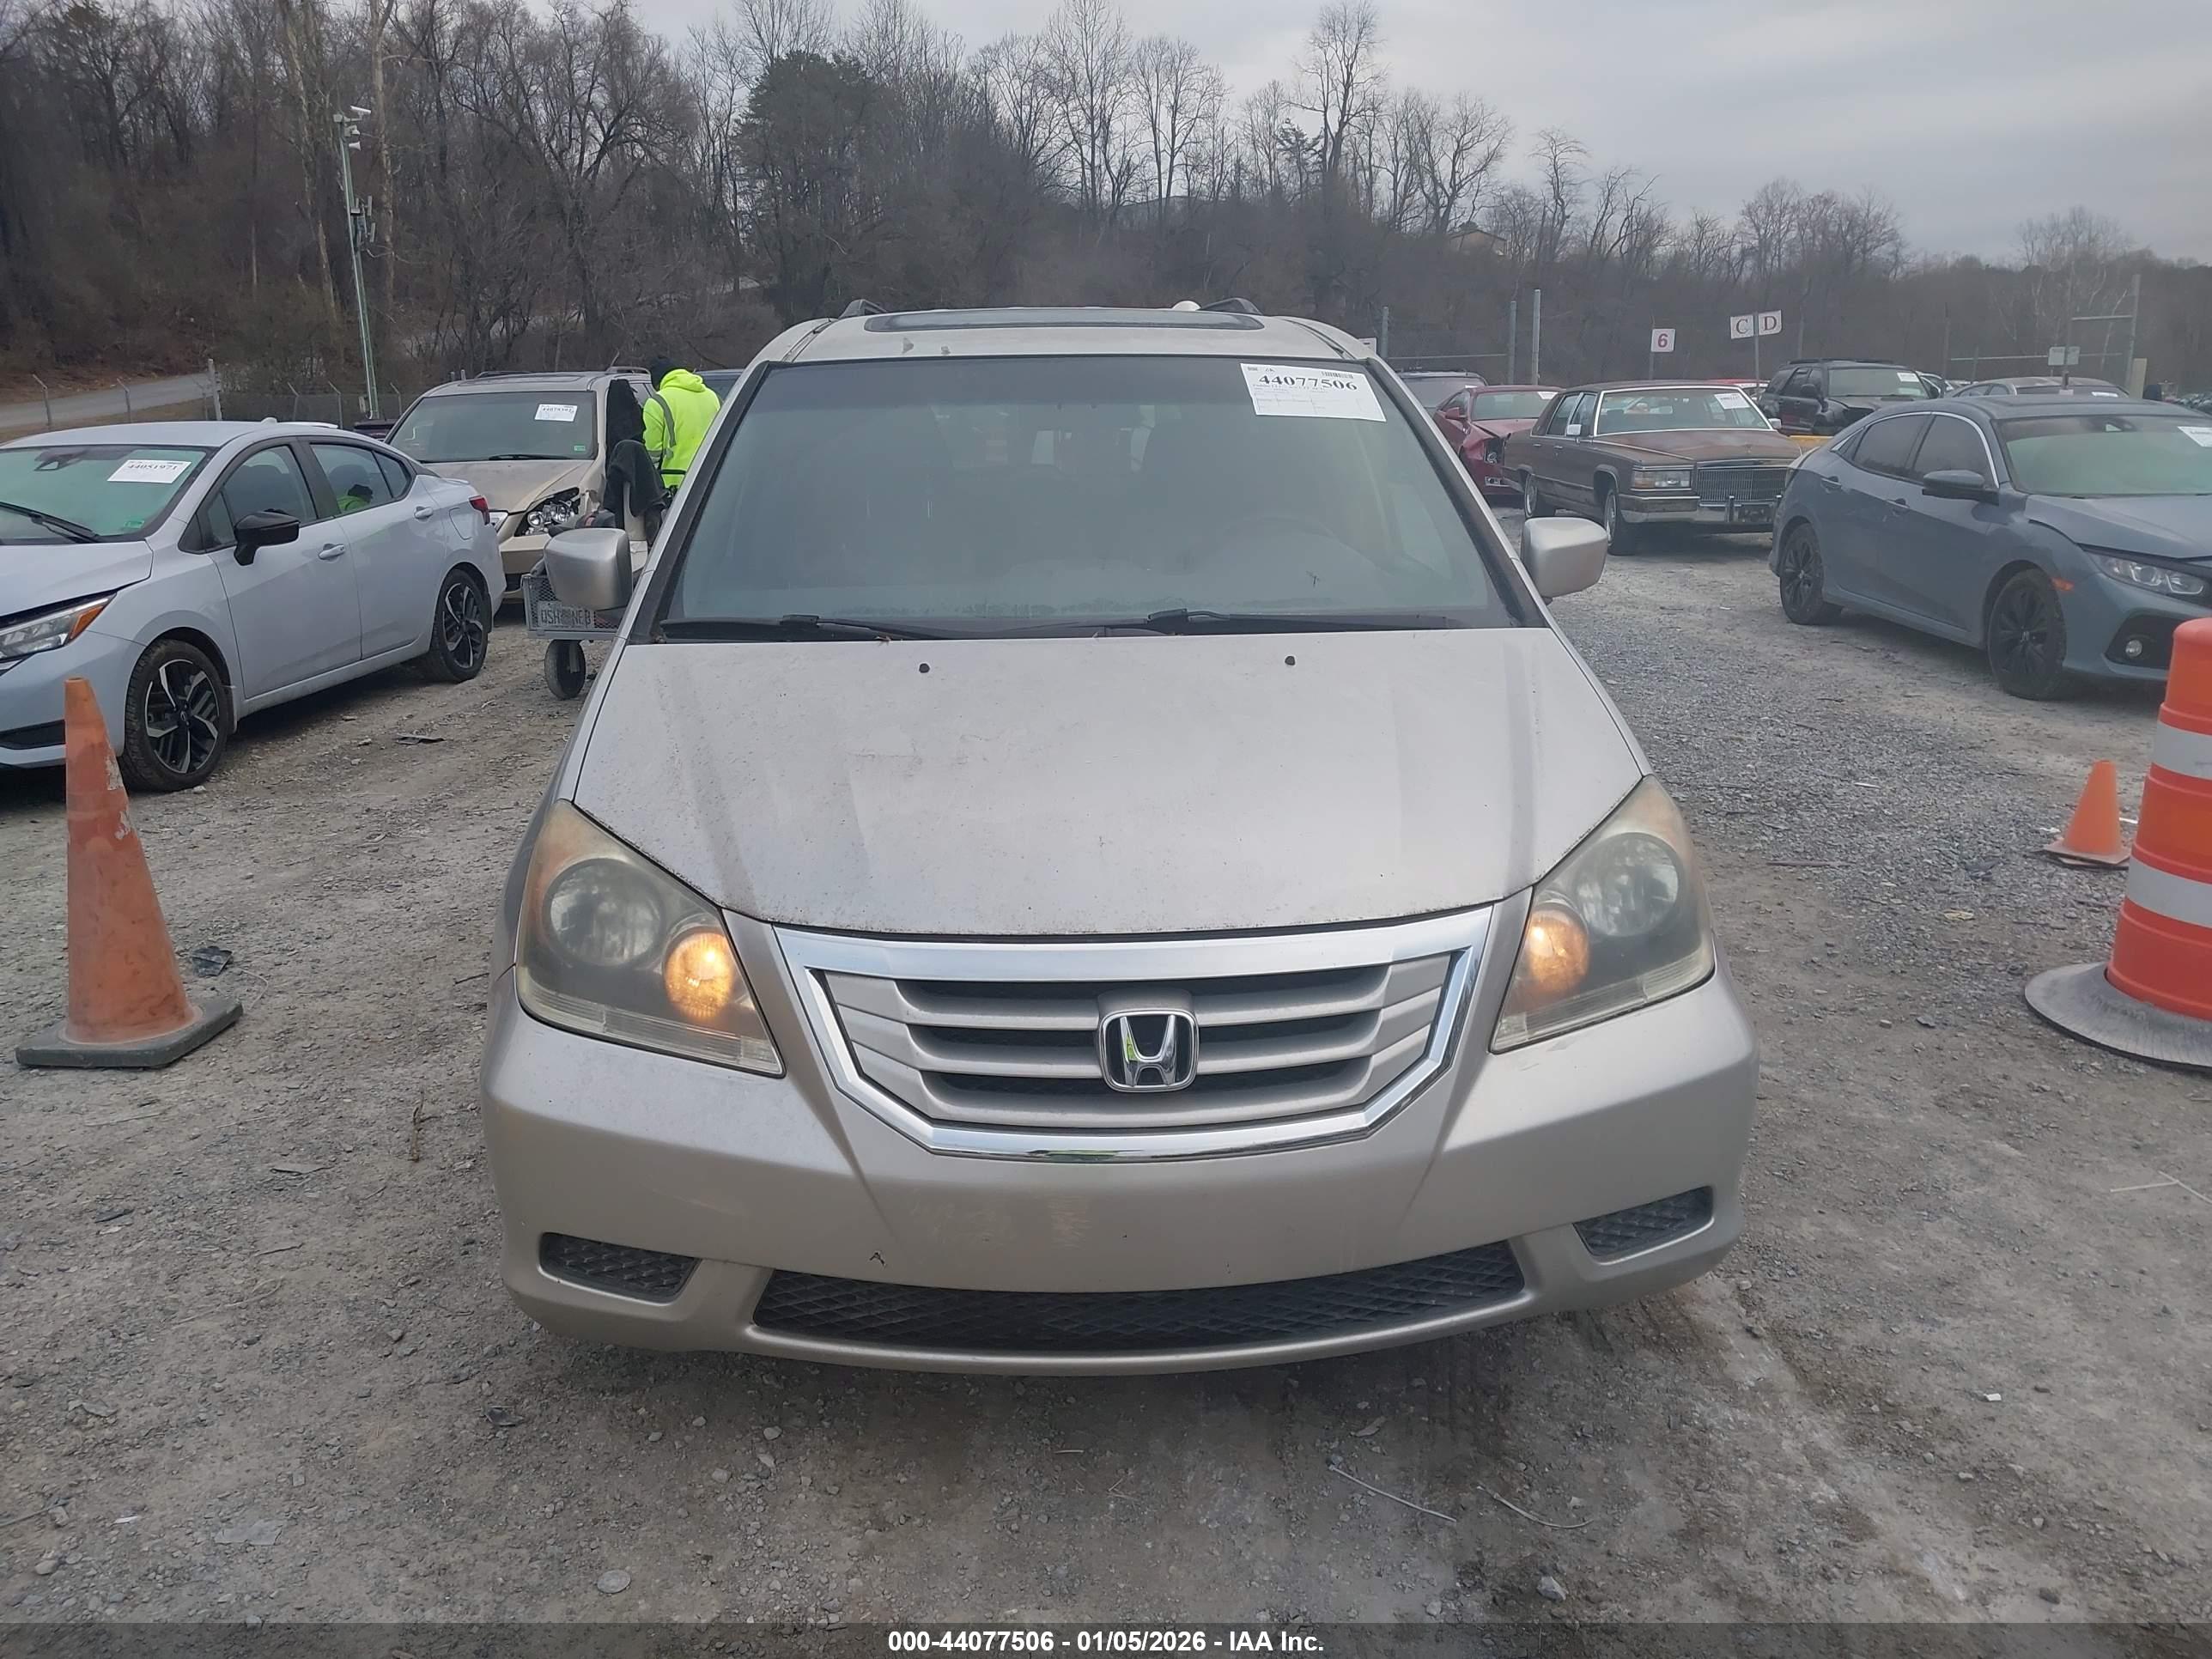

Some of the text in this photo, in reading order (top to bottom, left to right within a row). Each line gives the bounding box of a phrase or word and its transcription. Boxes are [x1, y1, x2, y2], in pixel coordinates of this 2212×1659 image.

[1735, 319, 1748, 334] C
[1764, 315, 1778, 331] D
[1657, 333, 1668, 349] 6
[1259, 374, 1358, 391] 44077506
